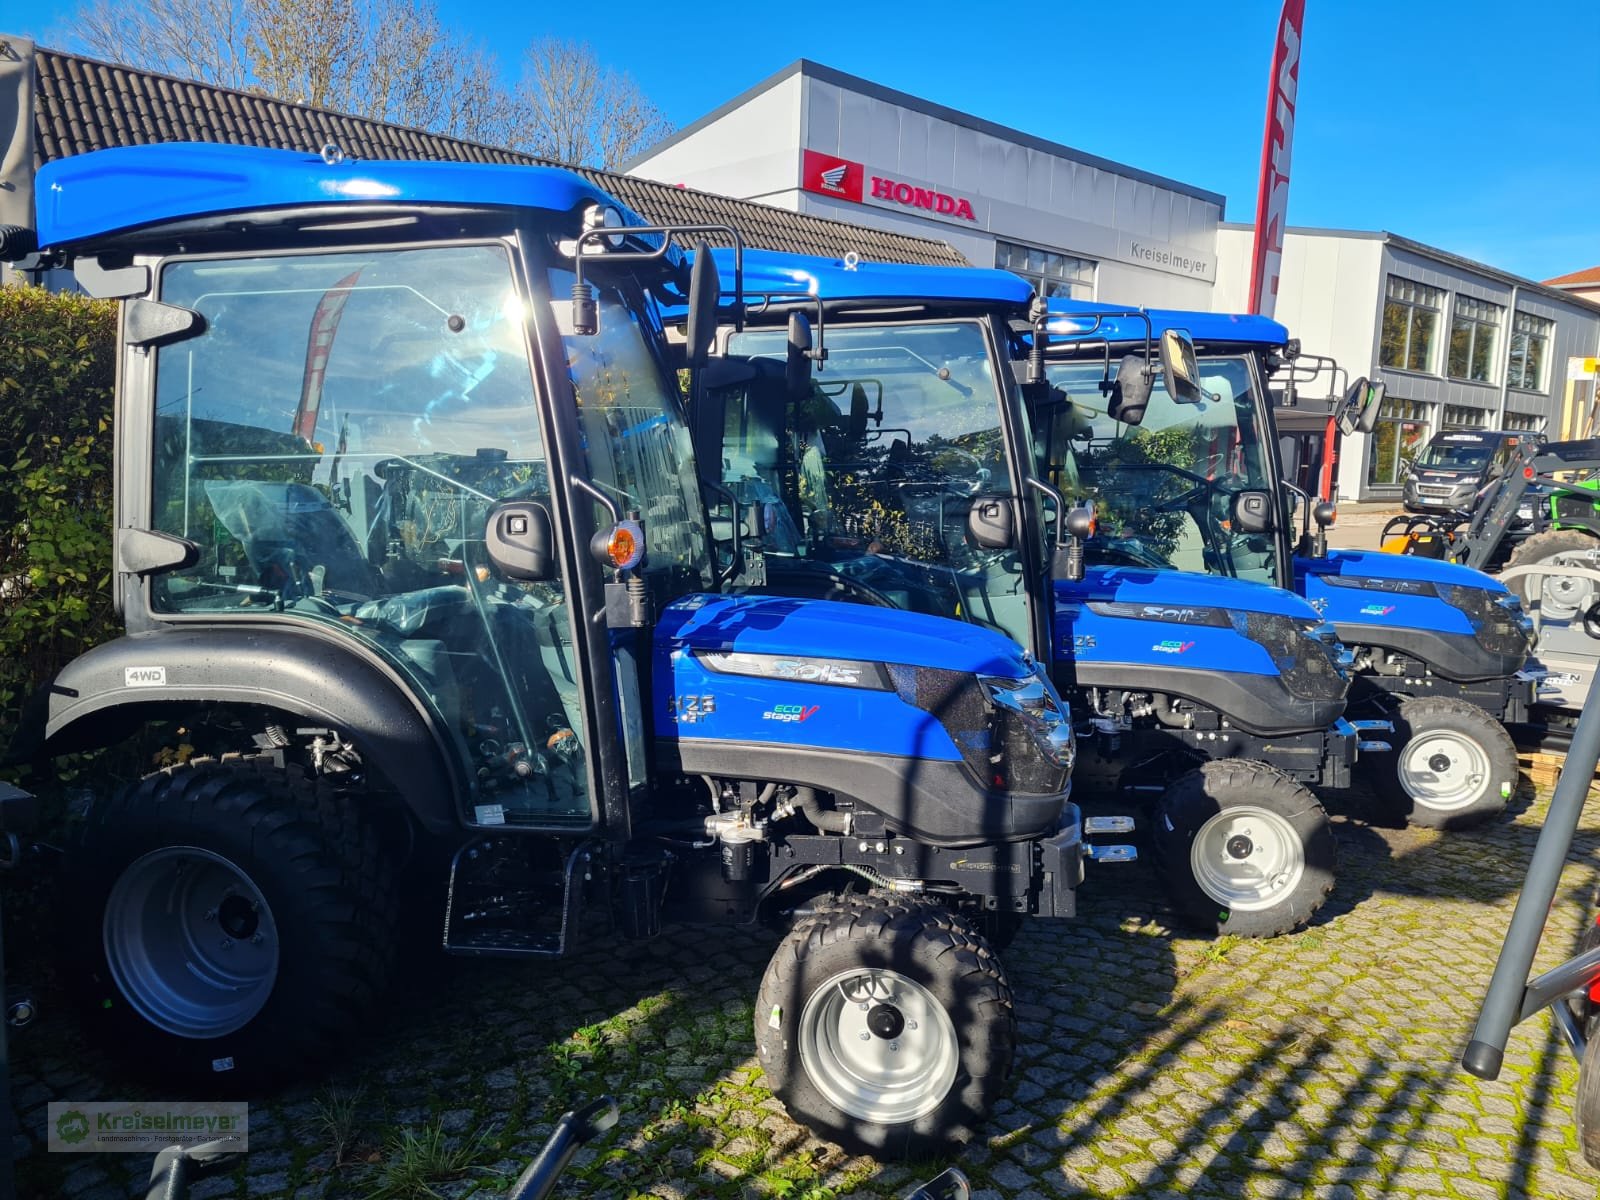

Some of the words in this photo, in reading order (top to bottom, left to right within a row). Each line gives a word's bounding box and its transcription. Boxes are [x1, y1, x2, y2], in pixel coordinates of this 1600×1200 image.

[871, 176, 976, 220] HONDA
[1130, 240, 1207, 272] Kreiselmeyer
[129, 670, 162, 682] 4WD
[774, 704, 802, 714] ECO
